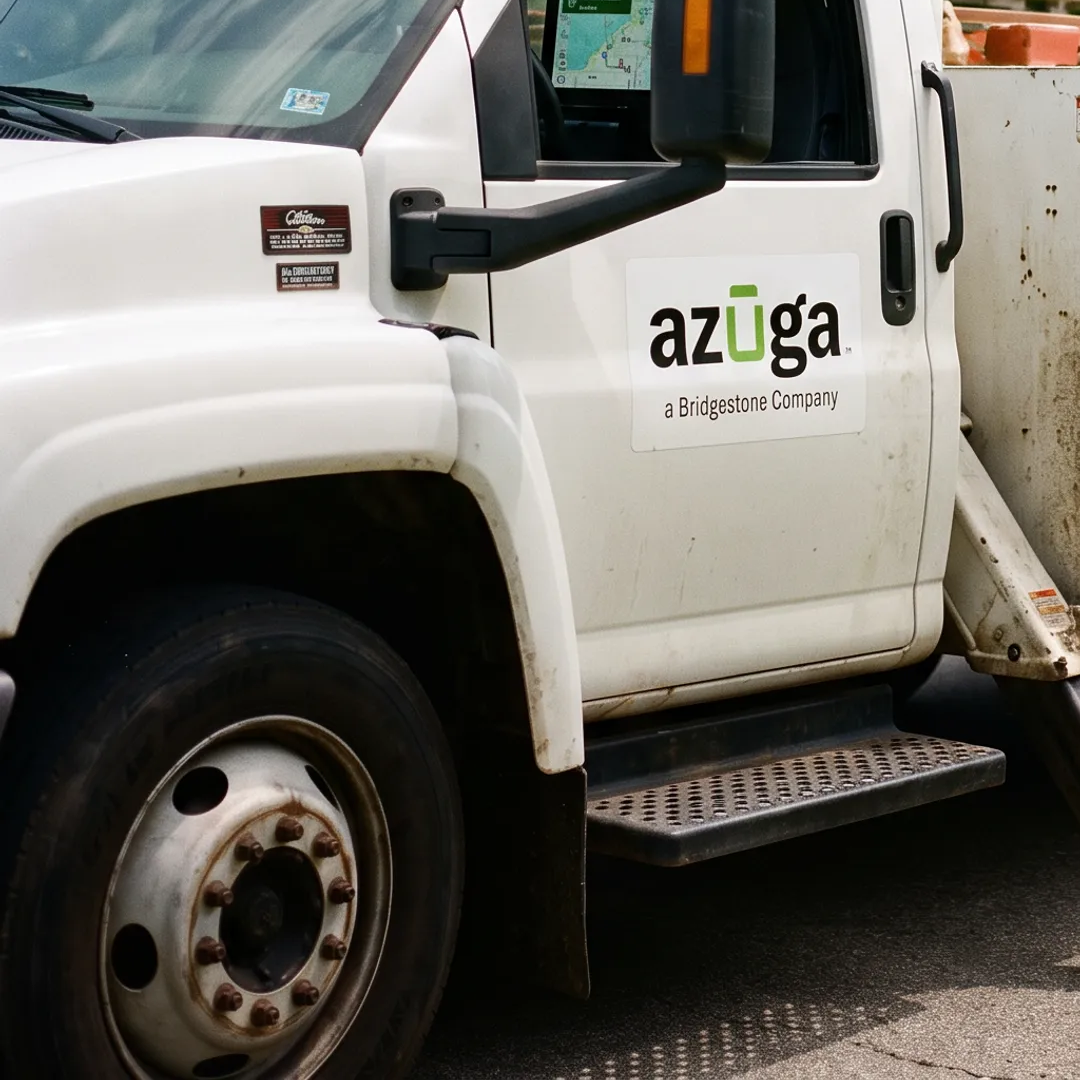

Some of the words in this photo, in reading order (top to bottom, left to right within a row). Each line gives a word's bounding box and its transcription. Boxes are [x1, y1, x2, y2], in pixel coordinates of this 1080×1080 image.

[665, 402, 674, 419] a
[679, 395, 768, 420] Bridgestone
[771, 390, 839, 412] Company
